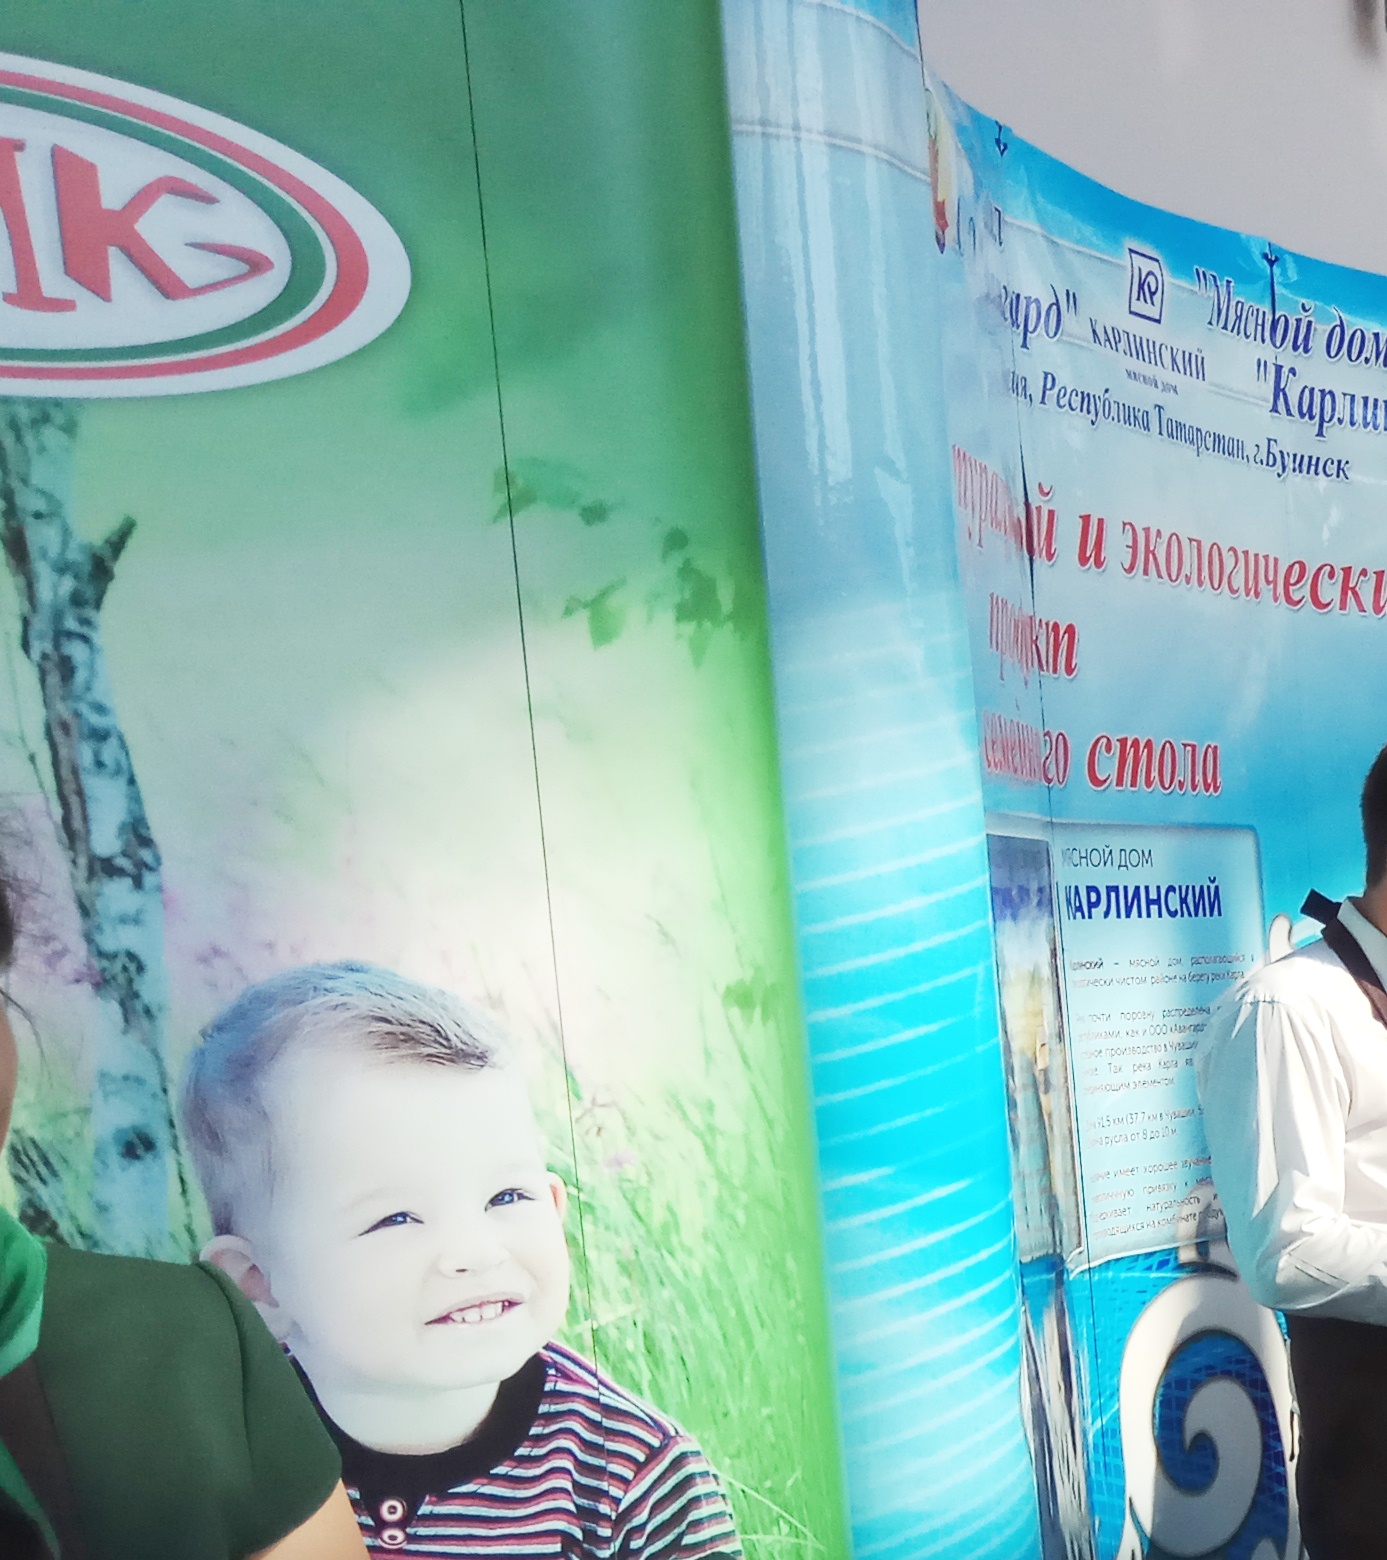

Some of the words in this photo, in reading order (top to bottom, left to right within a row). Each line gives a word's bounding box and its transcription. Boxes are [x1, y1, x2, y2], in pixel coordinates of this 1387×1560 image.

[1194, 267, 1314, 356] "Мясной
[1089, 316, 1206, 382] КАРЛИНСКИЙ
[1039, 371, 1152, 432] Республика
[1154, 404, 1250, 461] Татарстан,
[1077, 513, 1107, 570] и
[1086, 732, 1222, 795] стола
[1117, 848, 1153, 871] ДОМ
[1065, 876, 1222, 920] КАРЛИНСКИЙ
[1149, 1024, 1169, 1036] ООО
